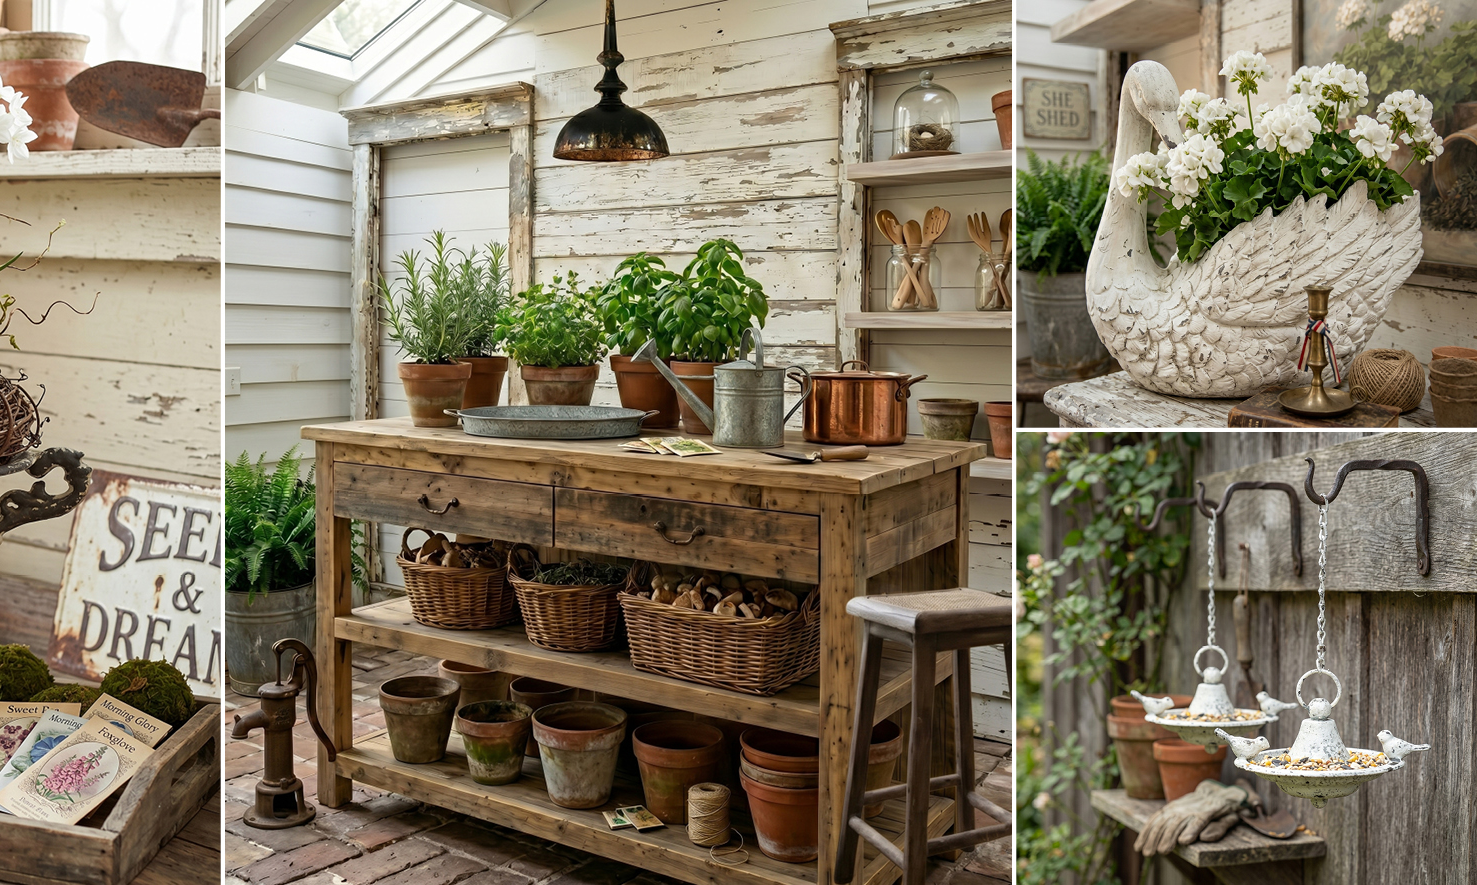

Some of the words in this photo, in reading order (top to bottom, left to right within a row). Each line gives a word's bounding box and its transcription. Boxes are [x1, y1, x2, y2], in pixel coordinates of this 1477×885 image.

[1041, 90, 1074, 108] SHE
[1036, 108, 1080, 127] SHED
[172, 571, 204, 614] &
[6, 704, 38, 714] Sweet
[100, 699, 135, 723] Morning
[134, 716, 160, 734] Glory
[48, 714, 83, 730] Morning
[97, 726, 136, 753] Foxglove
